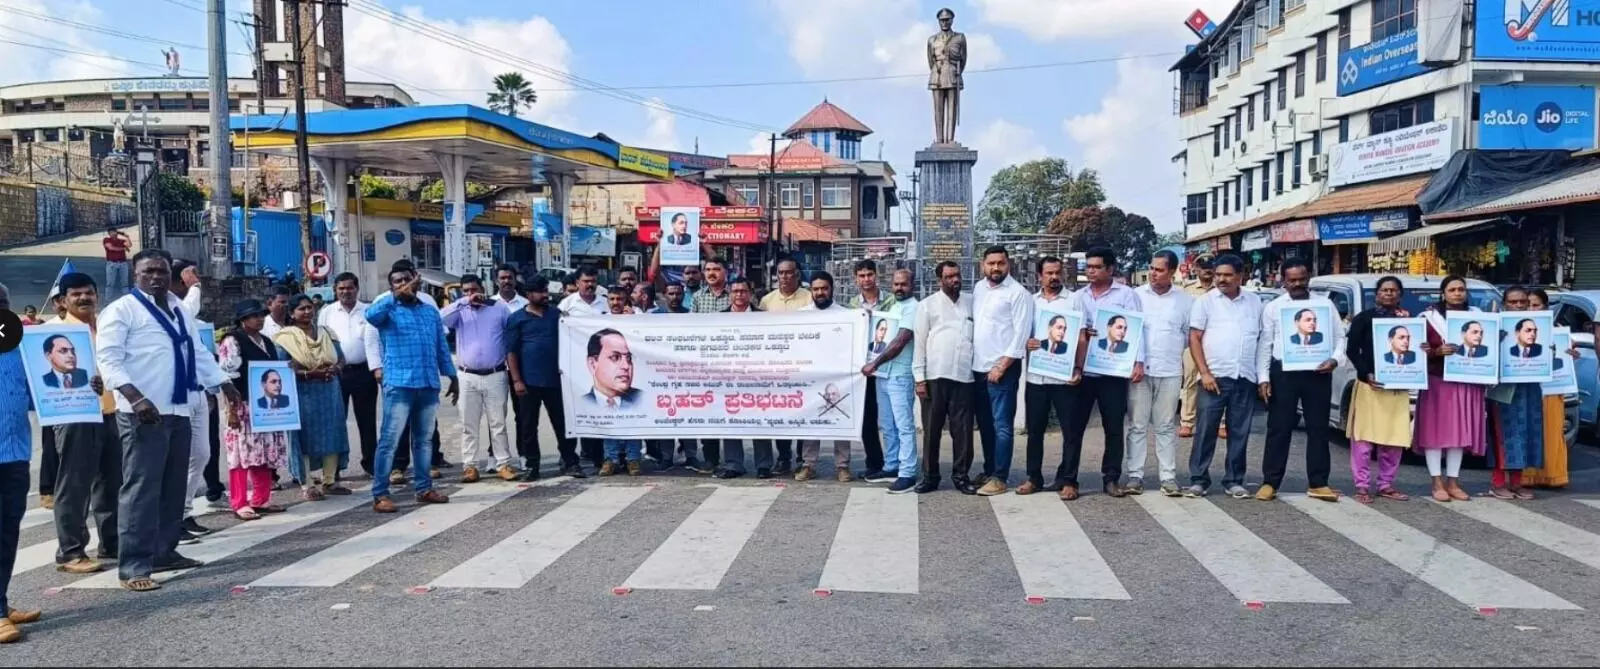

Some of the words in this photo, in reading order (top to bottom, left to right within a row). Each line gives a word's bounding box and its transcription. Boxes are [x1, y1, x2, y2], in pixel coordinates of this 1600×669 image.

[1361, 53, 1383, 68] Indian
[1537, 109, 1561, 124] Jio
[707, 232, 746, 240] CTIONARY
[656, 390, 714, 416] ಬೃಹತ್
[725, 390, 804, 415] ಪ್ರತಿಭಟನೆ
